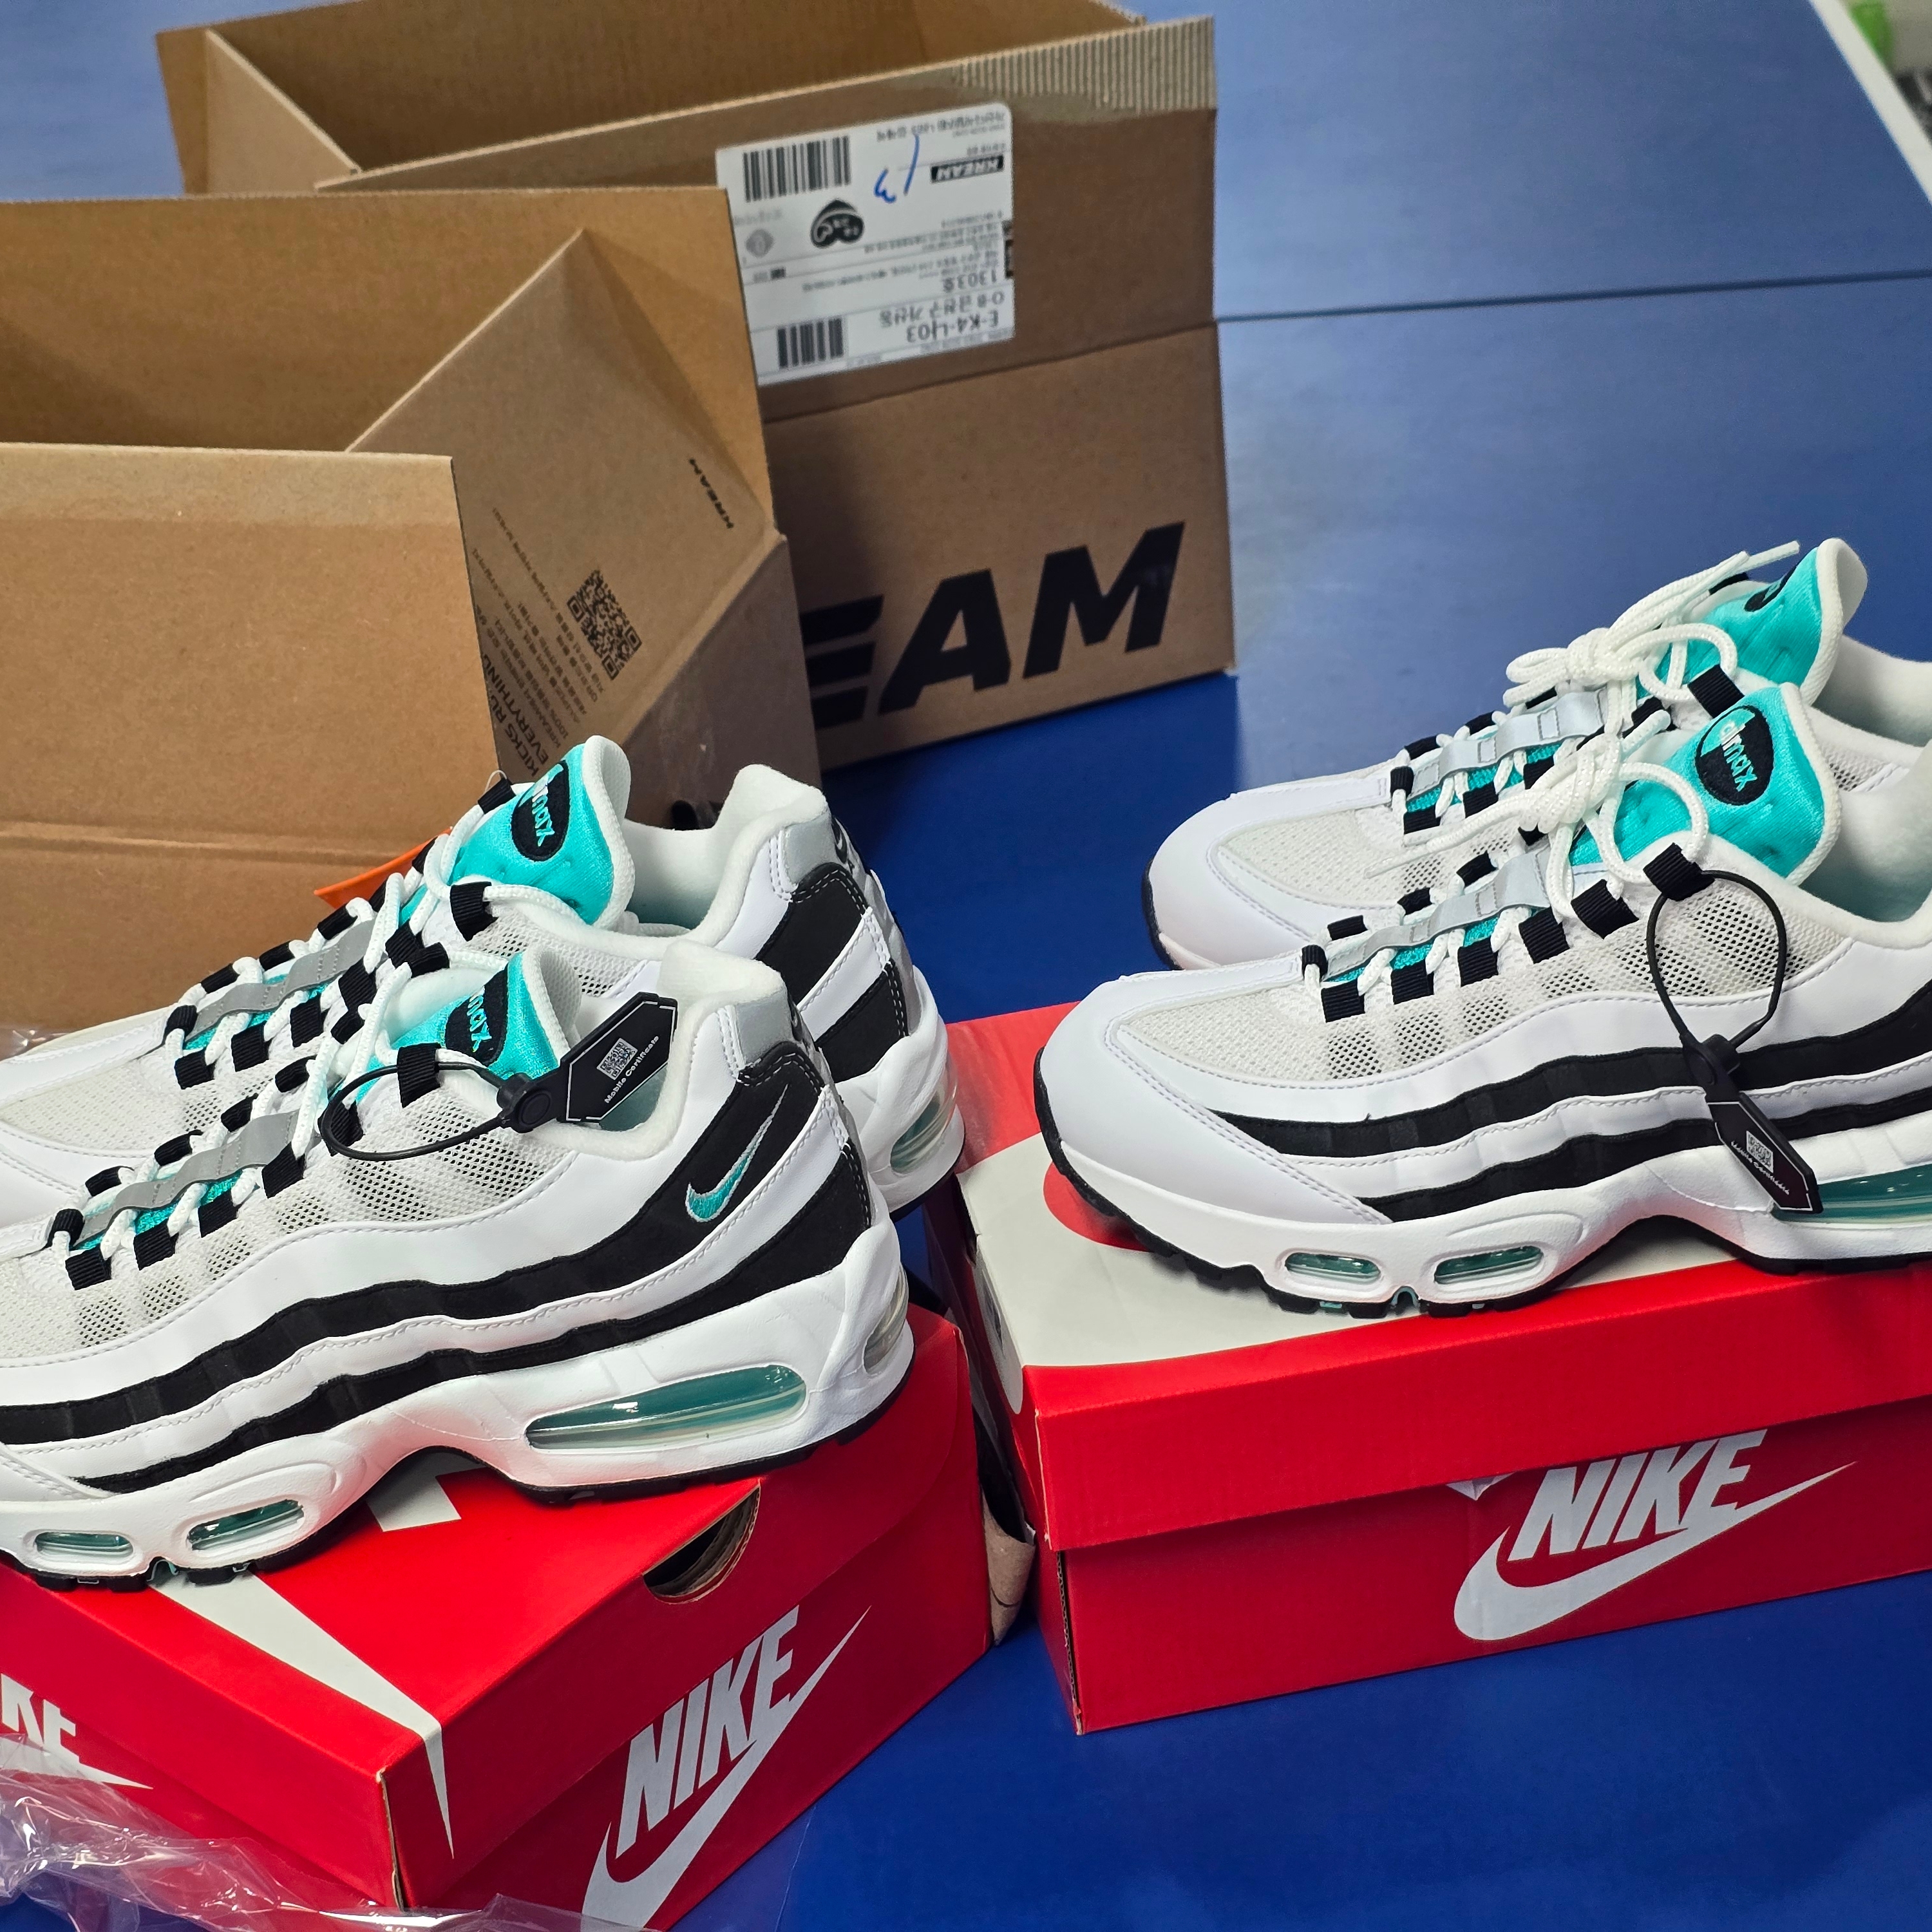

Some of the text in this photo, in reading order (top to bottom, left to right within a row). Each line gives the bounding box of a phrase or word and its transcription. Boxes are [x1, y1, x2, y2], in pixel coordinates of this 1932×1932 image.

[504, 721, 538, 777] KICKS
[604, 1077, 627, 1104] Mobile
[1508, 1428, 1768, 1562] NIKE
[616, 1604, 799, 1859] NIKE
